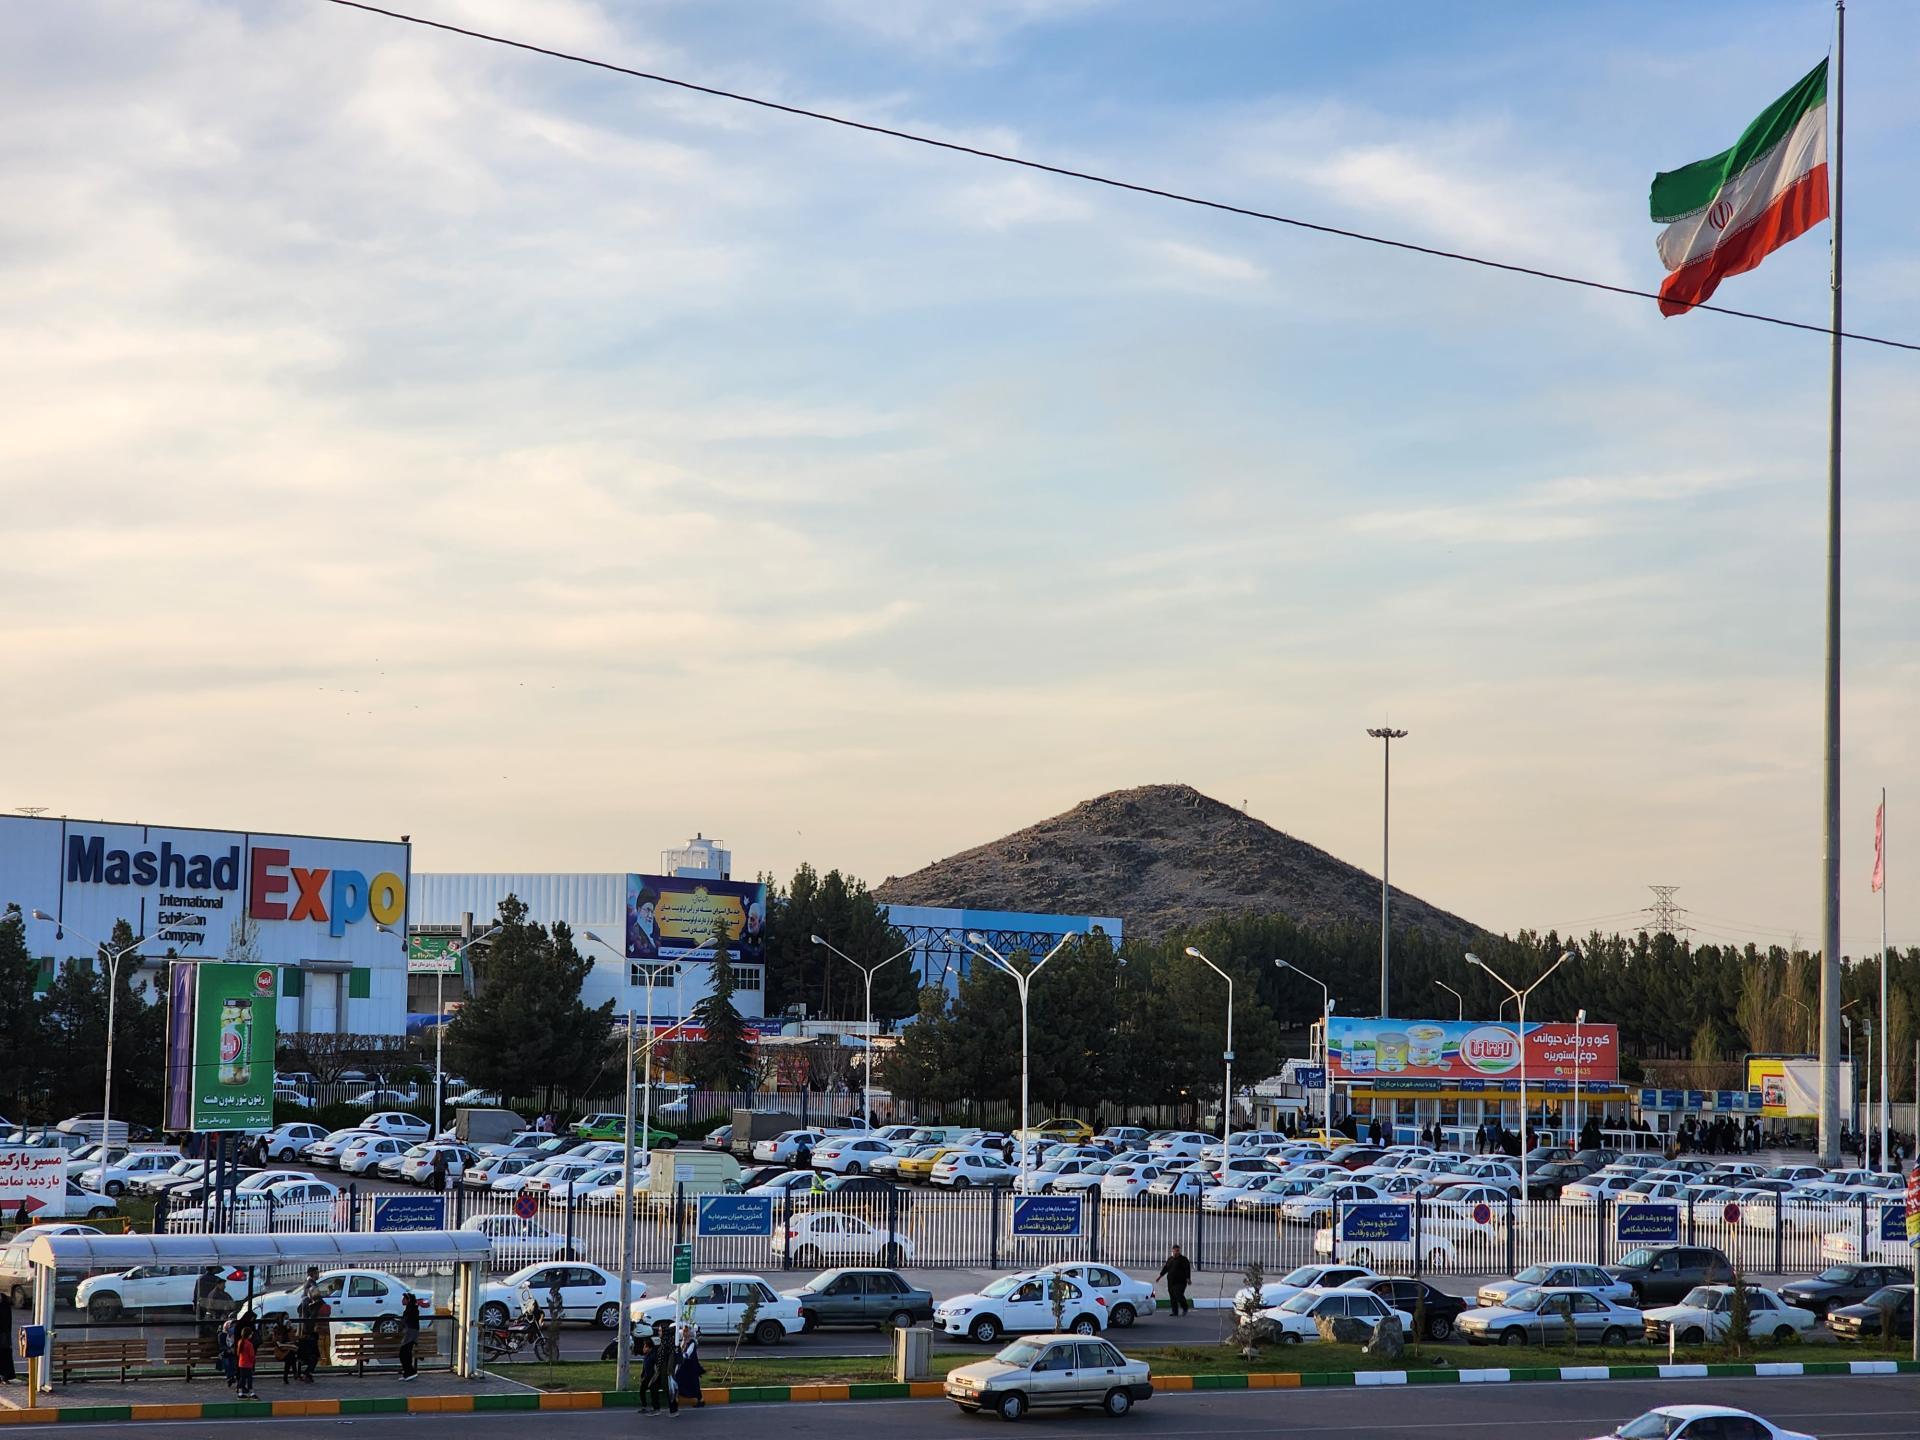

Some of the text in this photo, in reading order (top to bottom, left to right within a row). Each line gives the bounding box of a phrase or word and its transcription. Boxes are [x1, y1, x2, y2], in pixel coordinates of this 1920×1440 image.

[67, 835, 240, 890] Mashad
[250, 847, 405, 937] Expo
[159, 893, 224, 909] International
[158, 911, 207, 926] Exhibon
[157, 927, 206, 945] Company
[1533, 1033, 1563, 1046] حیوانی
[1587, 1036, 1593, 1047] و
[1594, 1034, 1610, 1047] کره
[1579, 1050, 1598, 1064] دوغ
[247, 1094, 265, 1106] زیتون
[0, 1152, 62, 1171] مسیر پارکی
[27, 1174, 60, 1189] بازدید
[736, 1204, 763, 1213] نمایشگاه
[708, 1213, 728, 1221] سرمایه
